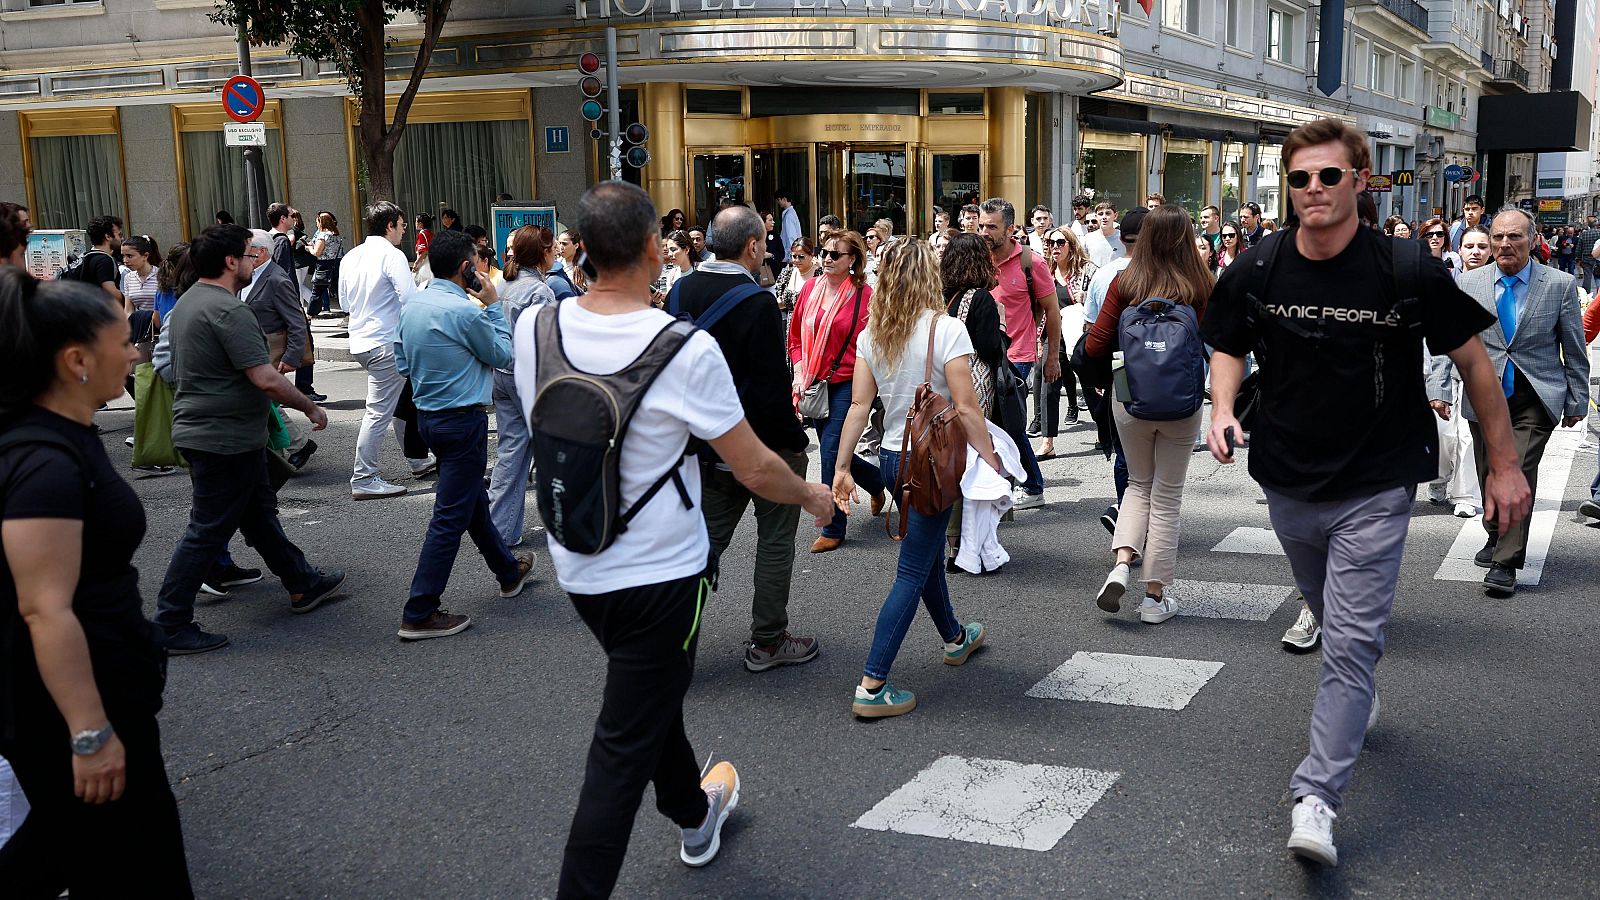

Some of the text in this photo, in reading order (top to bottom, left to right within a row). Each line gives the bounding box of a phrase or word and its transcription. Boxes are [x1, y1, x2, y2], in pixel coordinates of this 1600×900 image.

[552, 130, 562, 142] H
[1264, 304, 1398, 327] GANIC PEOPLE
